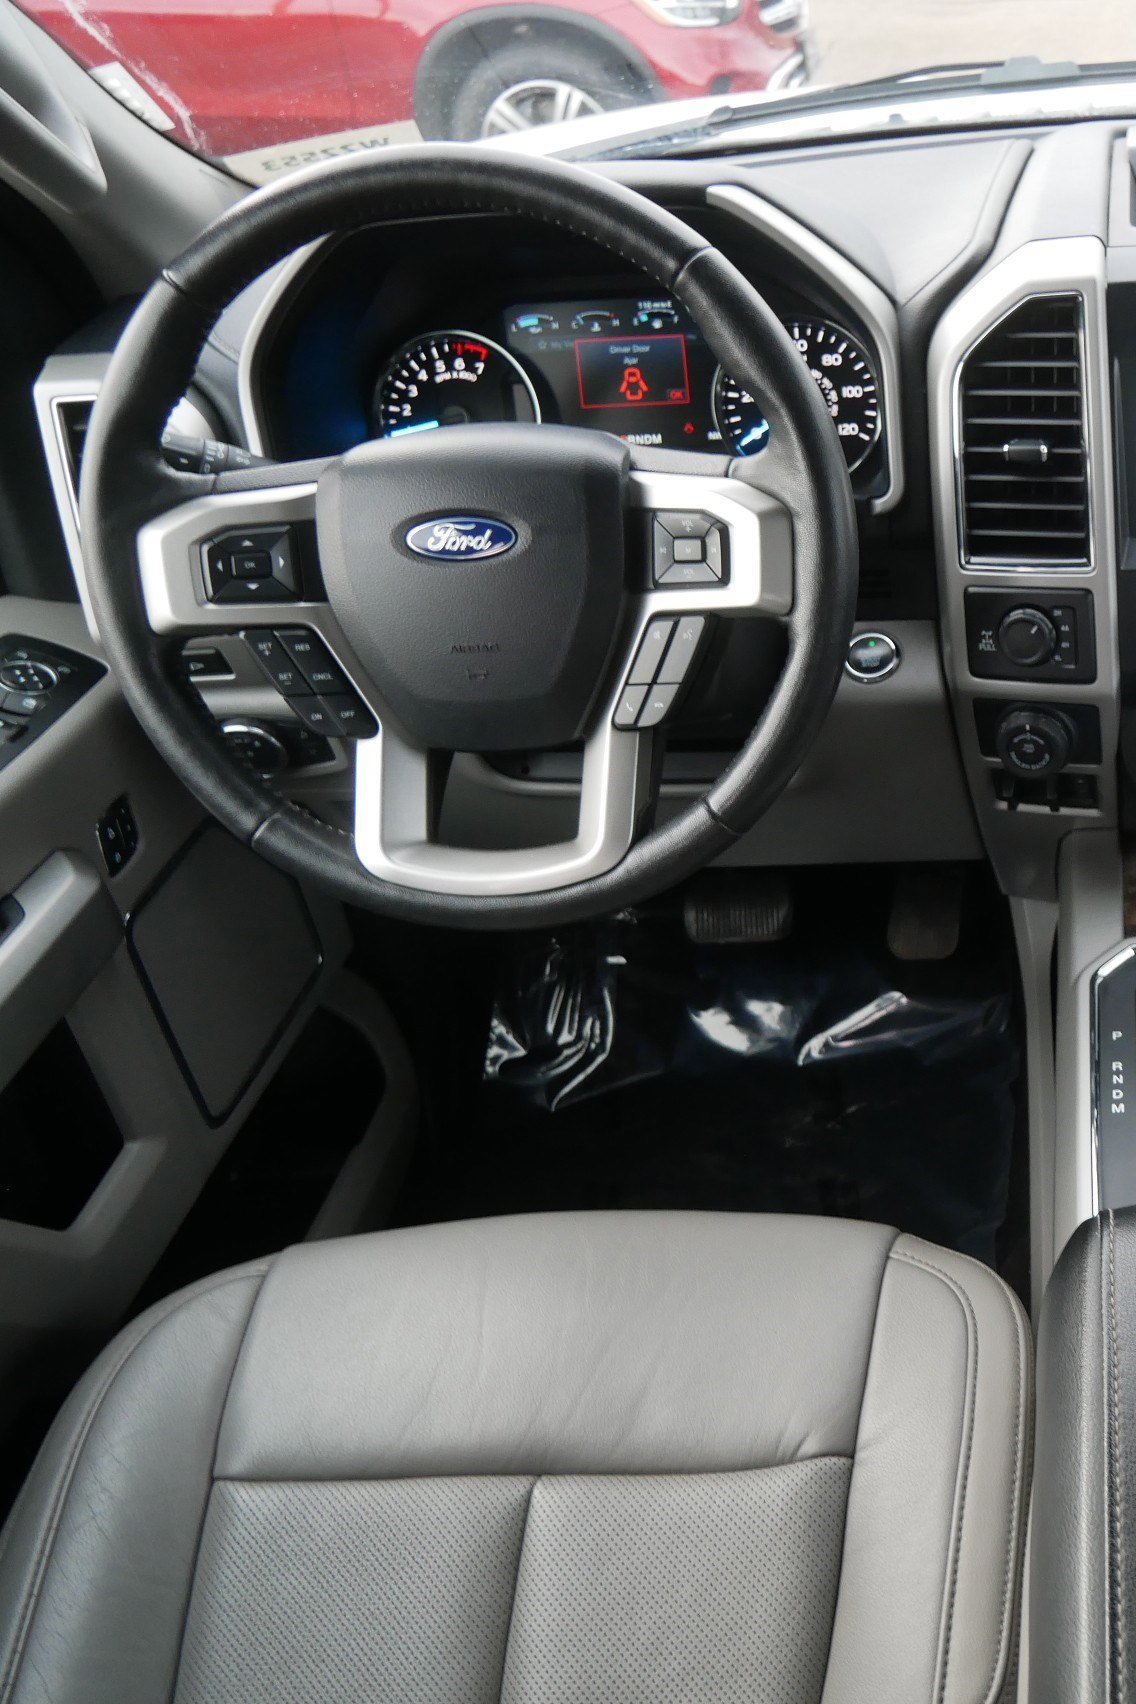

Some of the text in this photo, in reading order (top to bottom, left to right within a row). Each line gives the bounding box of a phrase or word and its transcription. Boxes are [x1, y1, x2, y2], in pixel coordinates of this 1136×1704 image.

[454, 357, 465, 370] 6
[821, 353, 842, 367] 80
[435, 360, 446, 373] 5
[474, 361, 485, 375] 7
[417, 369, 428, 382] 4
[407, 384, 418, 398] 3
[669, 389, 684, 400] OK
[841, 386, 863, 398] 100
[402, 403, 412, 417] 2
[838, 423, 859, 436] 120
[427, 523, 493, 551] Ford
[311, 712, 322, 720] ON
[341, 710, 355, 719] OFF
[1112, 1030, 1123, 1041] P
[1112, 1061, 1123, 1071] R
[1112, 1074, 1124, 1084] N
[1112, 1089, 1124, 1099] D
[1111, 1103, 1125, 1114] M
